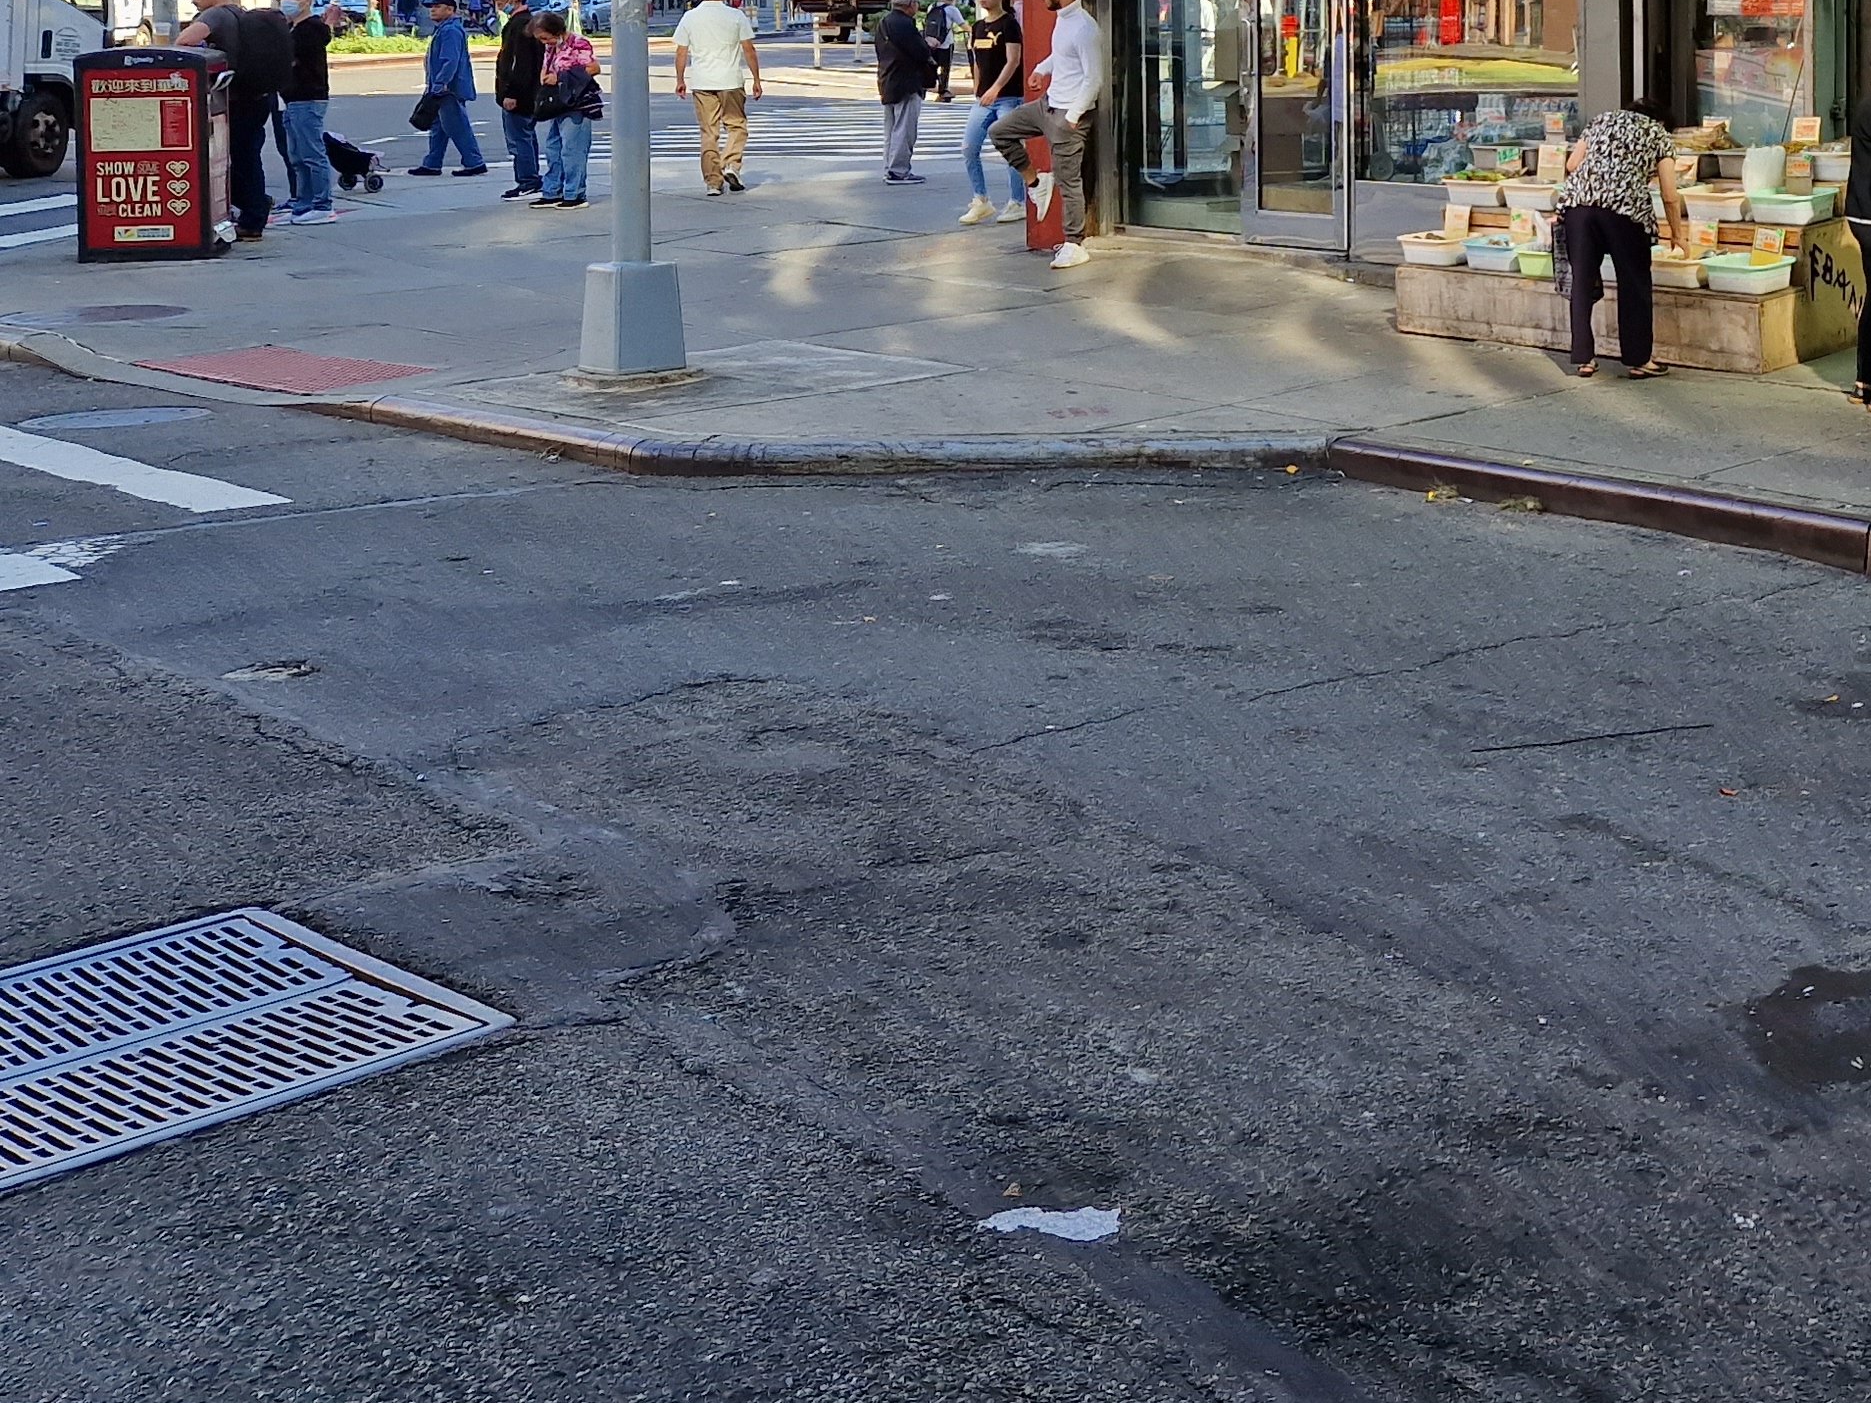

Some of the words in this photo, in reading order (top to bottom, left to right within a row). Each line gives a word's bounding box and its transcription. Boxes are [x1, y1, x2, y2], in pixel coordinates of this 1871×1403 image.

[96, 161, 135, 176] SHOW
[96, 176, 161, 202] LOVE
[118, 203, 162, 217] CLEAN
